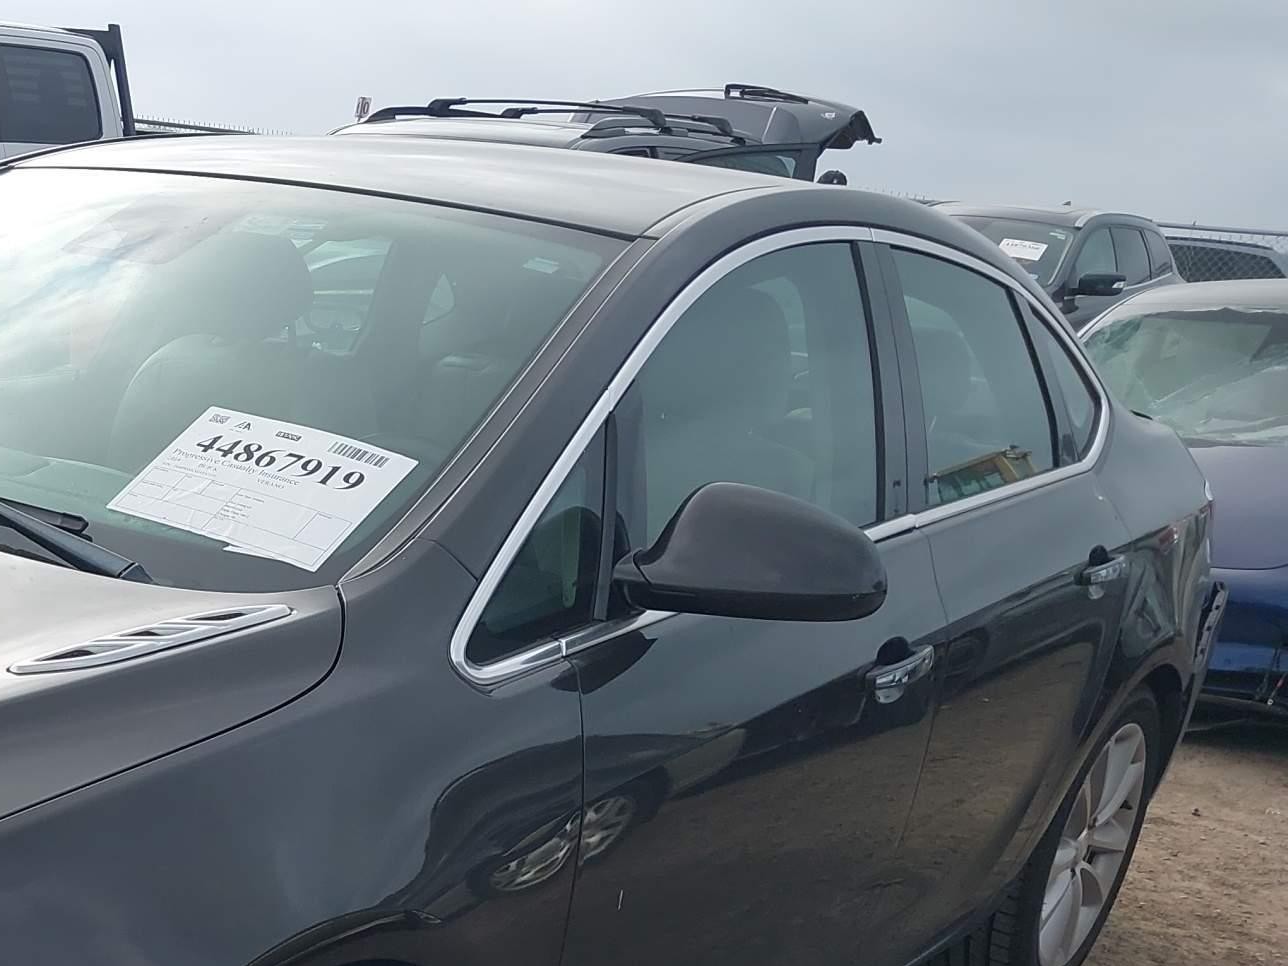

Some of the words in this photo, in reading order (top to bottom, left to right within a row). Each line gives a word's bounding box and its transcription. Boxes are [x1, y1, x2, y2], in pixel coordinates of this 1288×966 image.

[172, 447, 221, 465] Progressive
[258, 468, 301, 487] Insurance
[196, 435, 366, 490] 44867919
